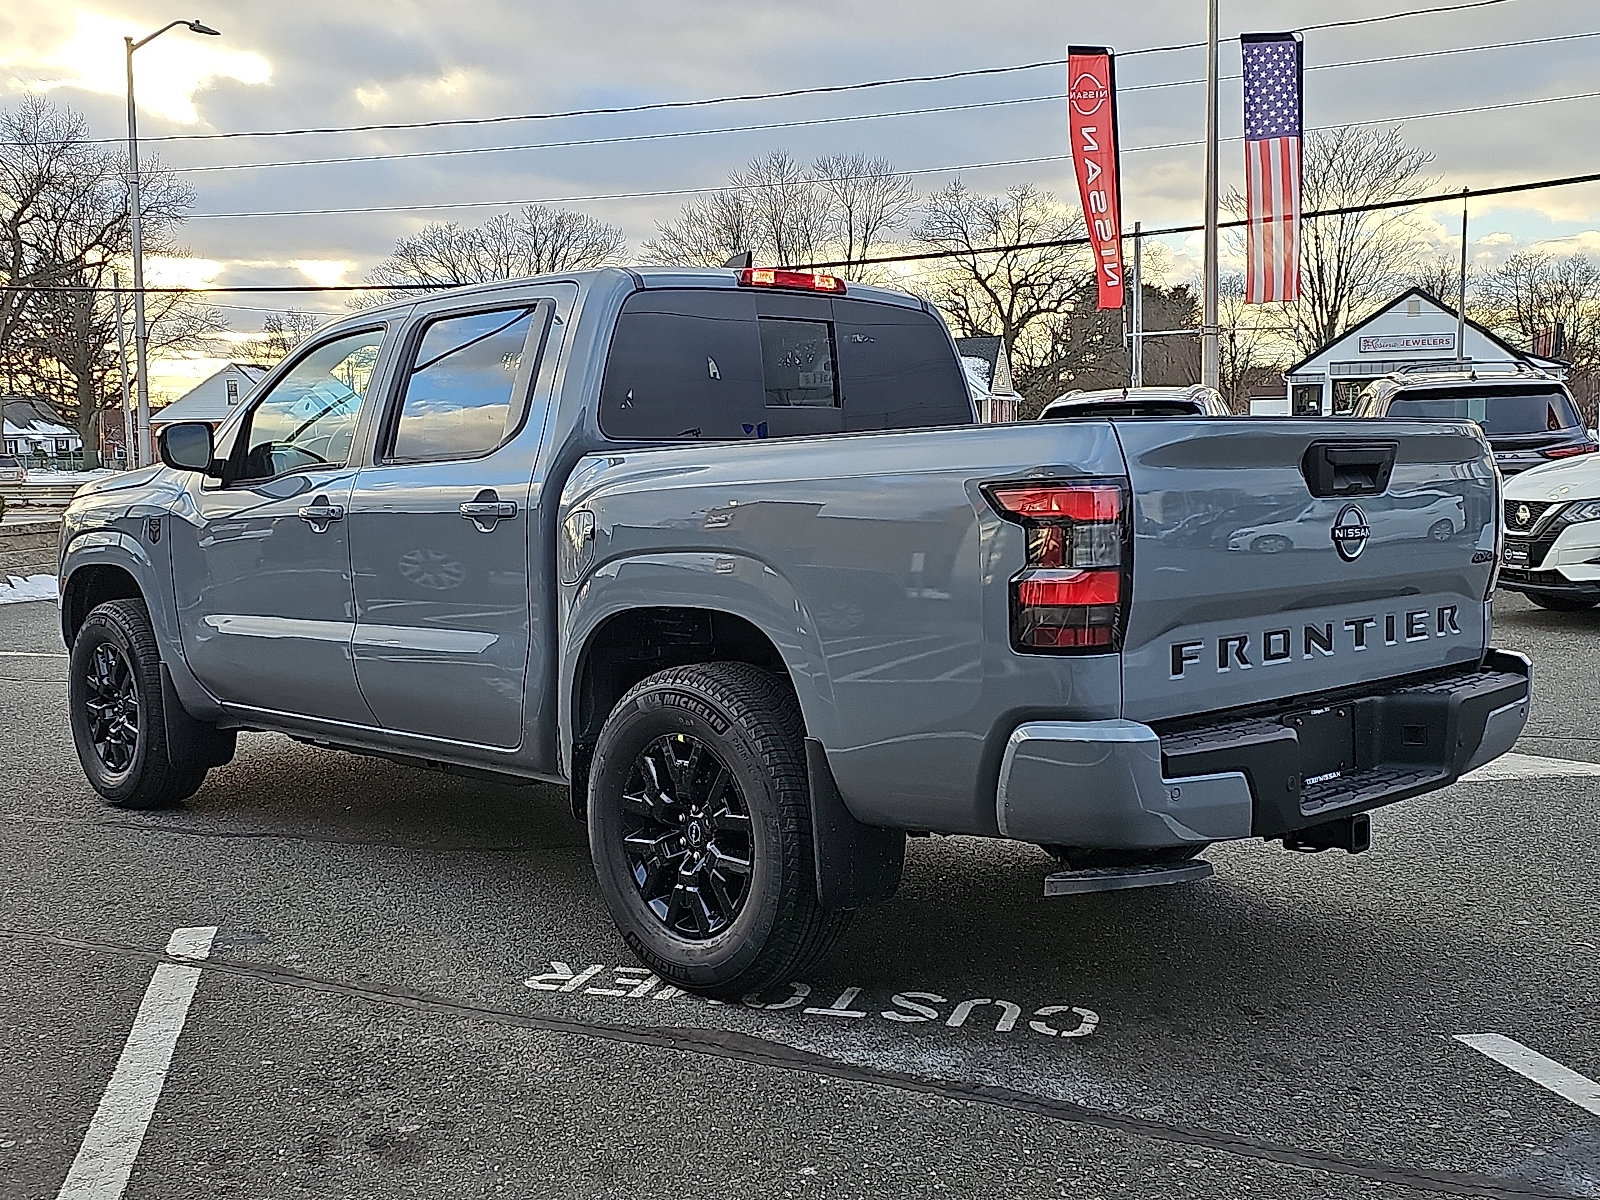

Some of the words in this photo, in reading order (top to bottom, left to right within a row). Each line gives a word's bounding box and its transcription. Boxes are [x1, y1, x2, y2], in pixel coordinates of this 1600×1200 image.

[1400, 338, 1451, 347] JEWELERS
[1334, 525, 1371, 539] NISSAN
[1168, 604, 1461, 681] FRONTIER
[663, 693, 726, 732] MICHELIN
[523, 960, 1100, 1039] CUSTOER
